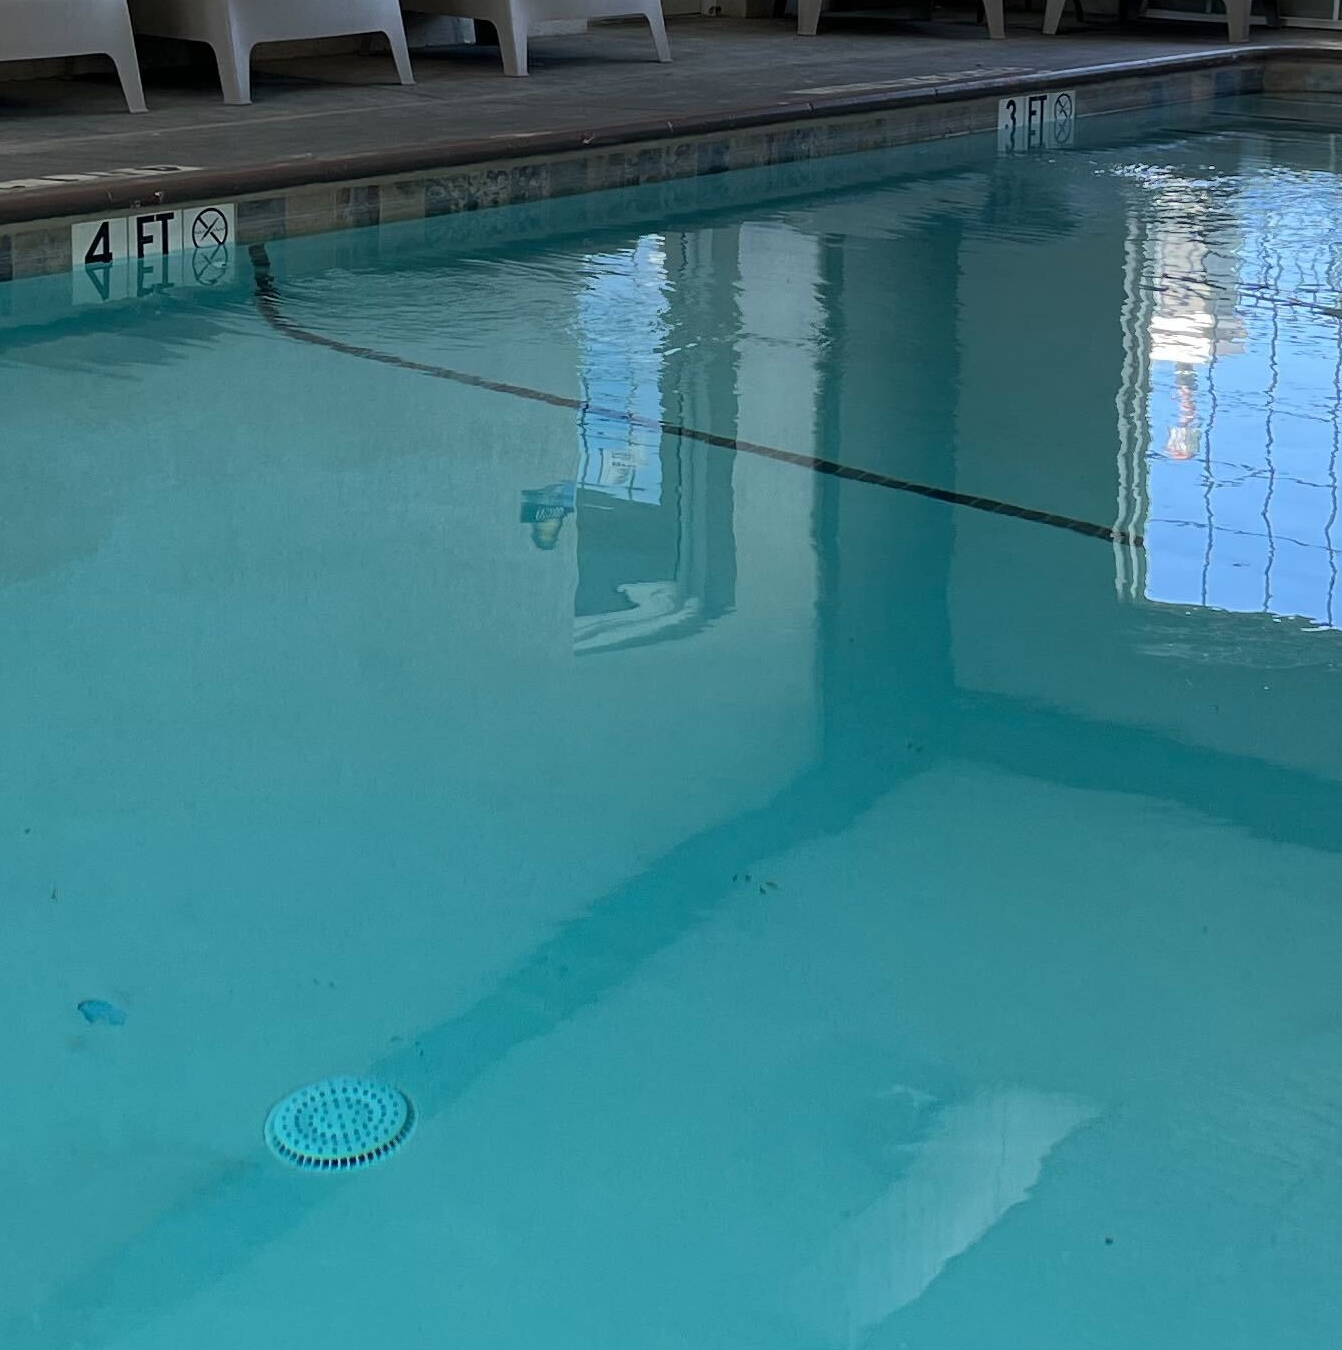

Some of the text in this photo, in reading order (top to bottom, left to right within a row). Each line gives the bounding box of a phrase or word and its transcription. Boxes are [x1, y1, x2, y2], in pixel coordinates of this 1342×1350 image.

[1006, 95, 1047, 129] 3 FT
[85, 212, 174, 264] 4 FT
